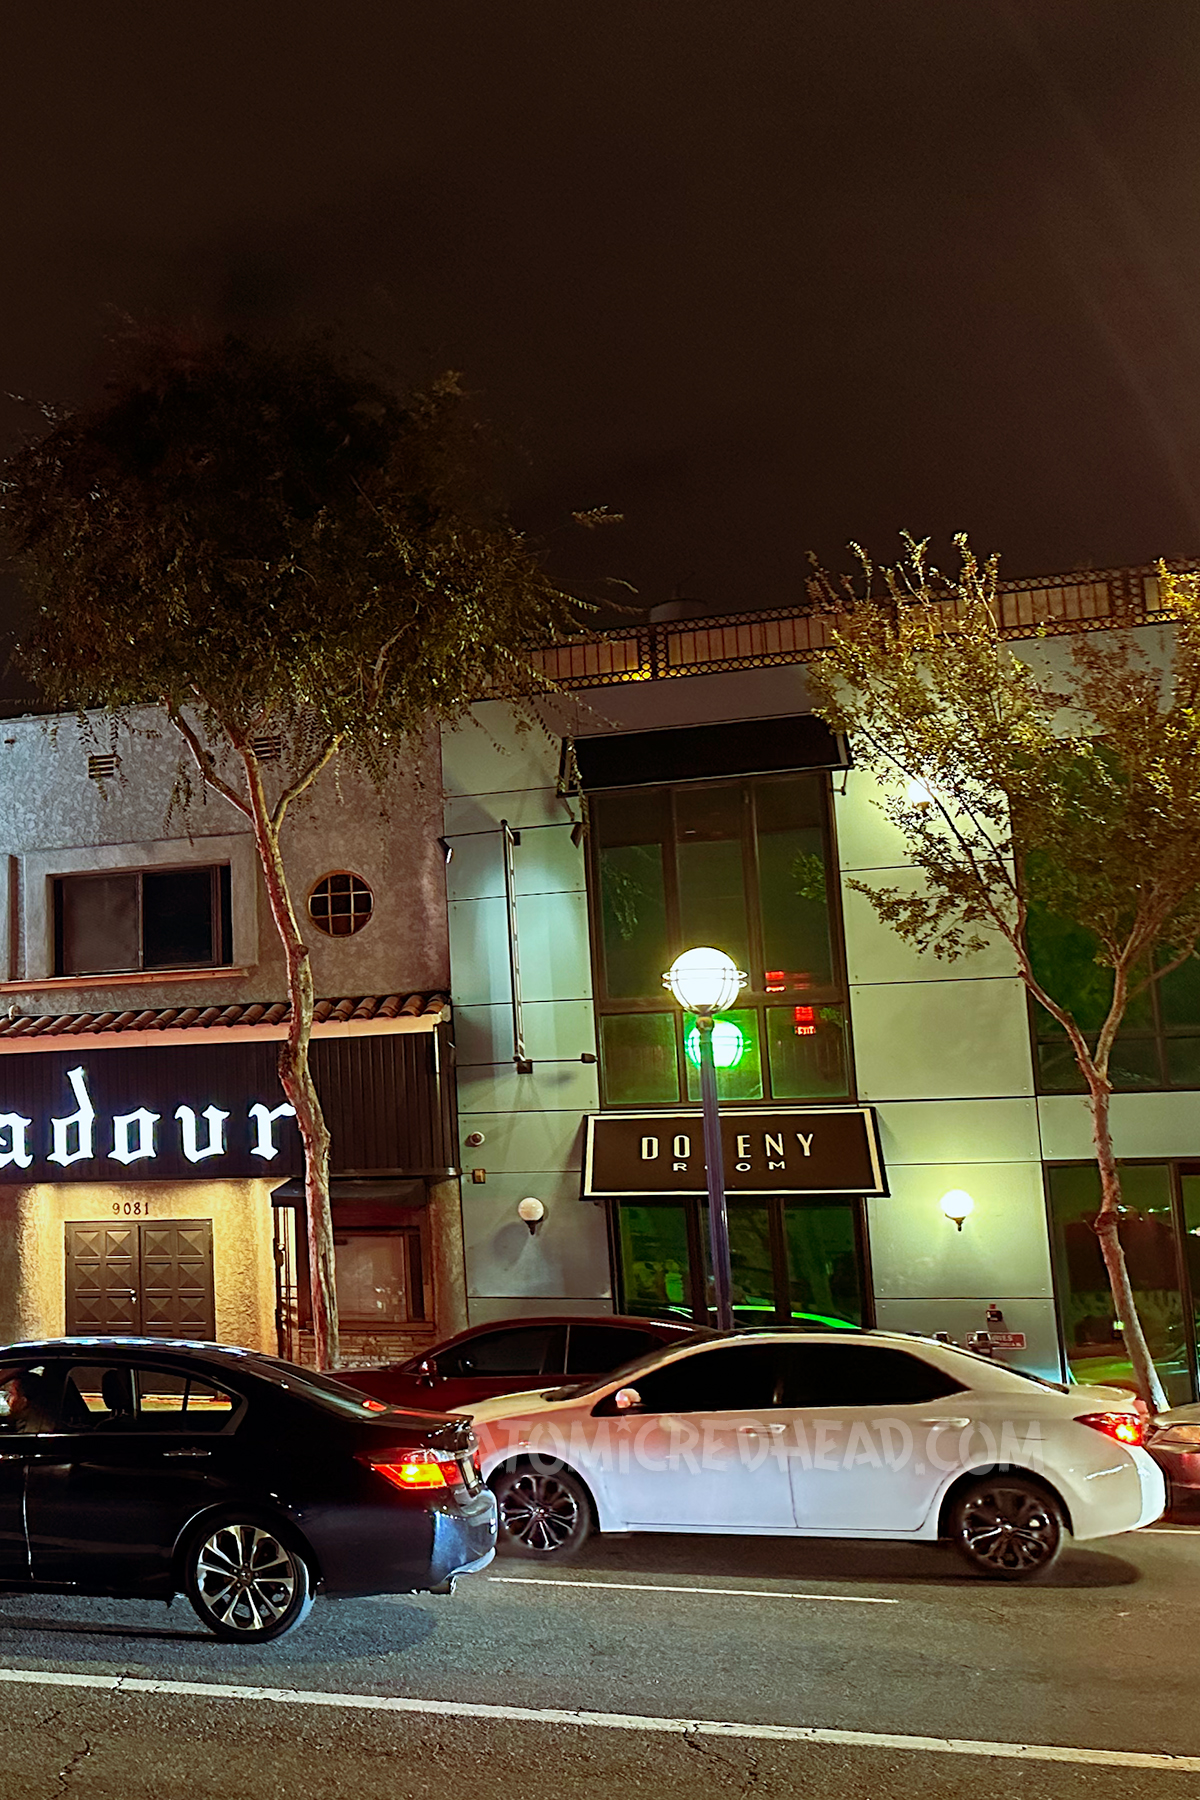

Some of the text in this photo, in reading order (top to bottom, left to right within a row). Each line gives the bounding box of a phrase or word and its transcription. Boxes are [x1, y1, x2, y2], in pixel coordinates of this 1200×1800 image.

[641, 1133, 814, 1160] DOENY
[672, 1161, 786, 1172] ROM
[112, 1202, 149, 1215] 9081
